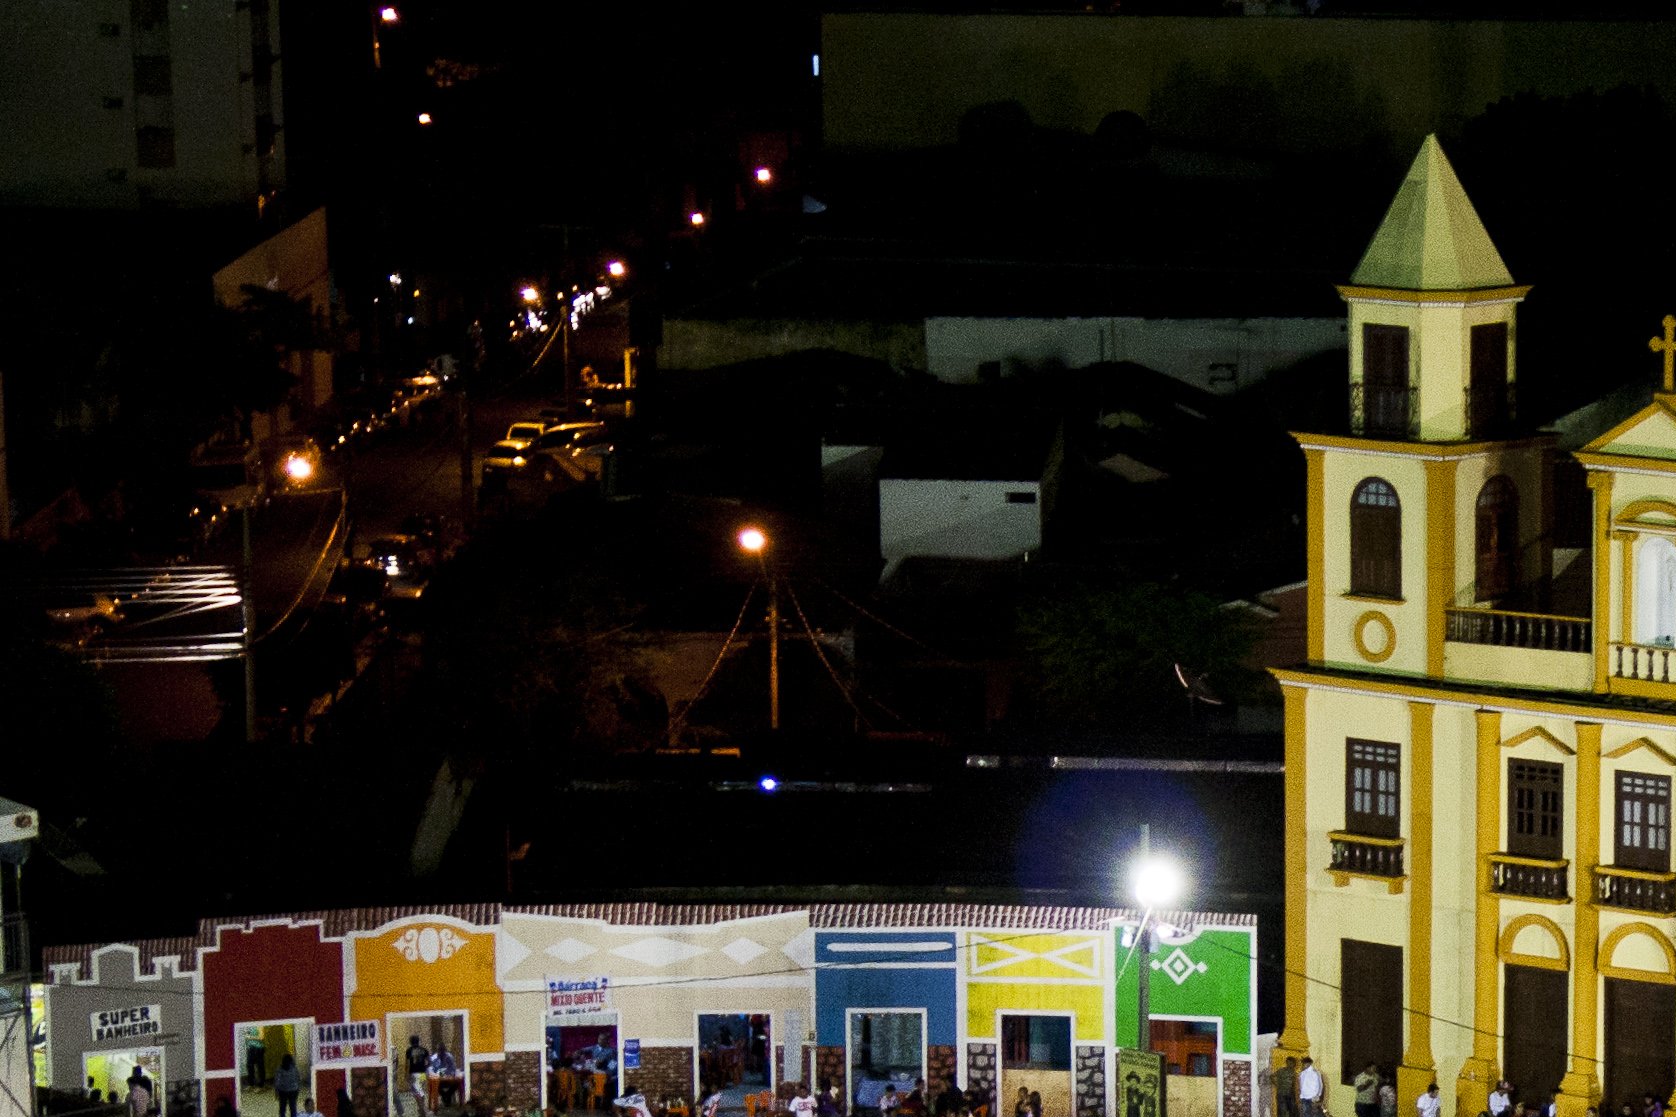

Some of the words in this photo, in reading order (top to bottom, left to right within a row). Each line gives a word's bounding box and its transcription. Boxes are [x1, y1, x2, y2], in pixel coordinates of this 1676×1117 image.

[99, 1007, 150, 1026] SUPER
[97, 1021, 158, 1040] BANHEIRO
[318, 1023, 376, 1042] BANHEIRO
